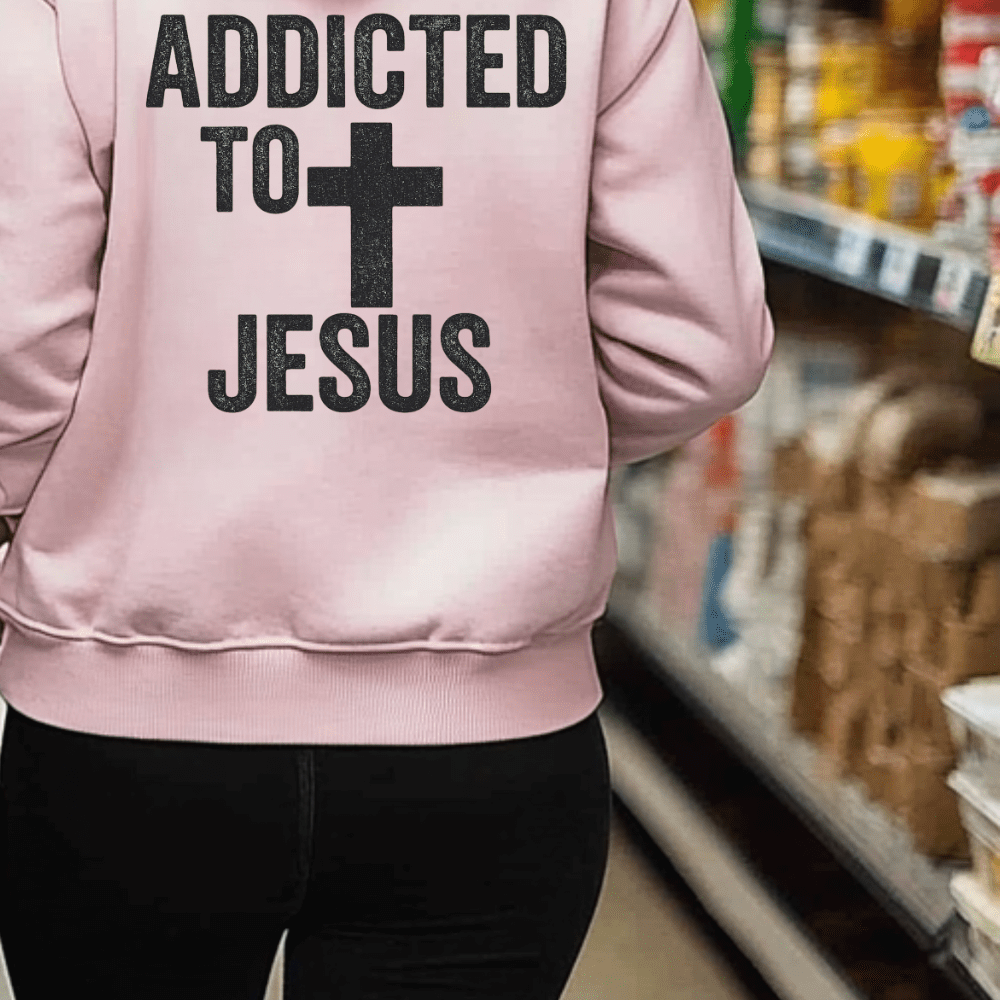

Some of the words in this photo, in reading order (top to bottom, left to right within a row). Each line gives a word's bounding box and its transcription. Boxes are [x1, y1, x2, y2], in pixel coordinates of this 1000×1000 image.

[146, 13, 567, 109] ADDICTED
[200, 124, 300, 214] TO
[208, 313, 492, 413] JESUS
